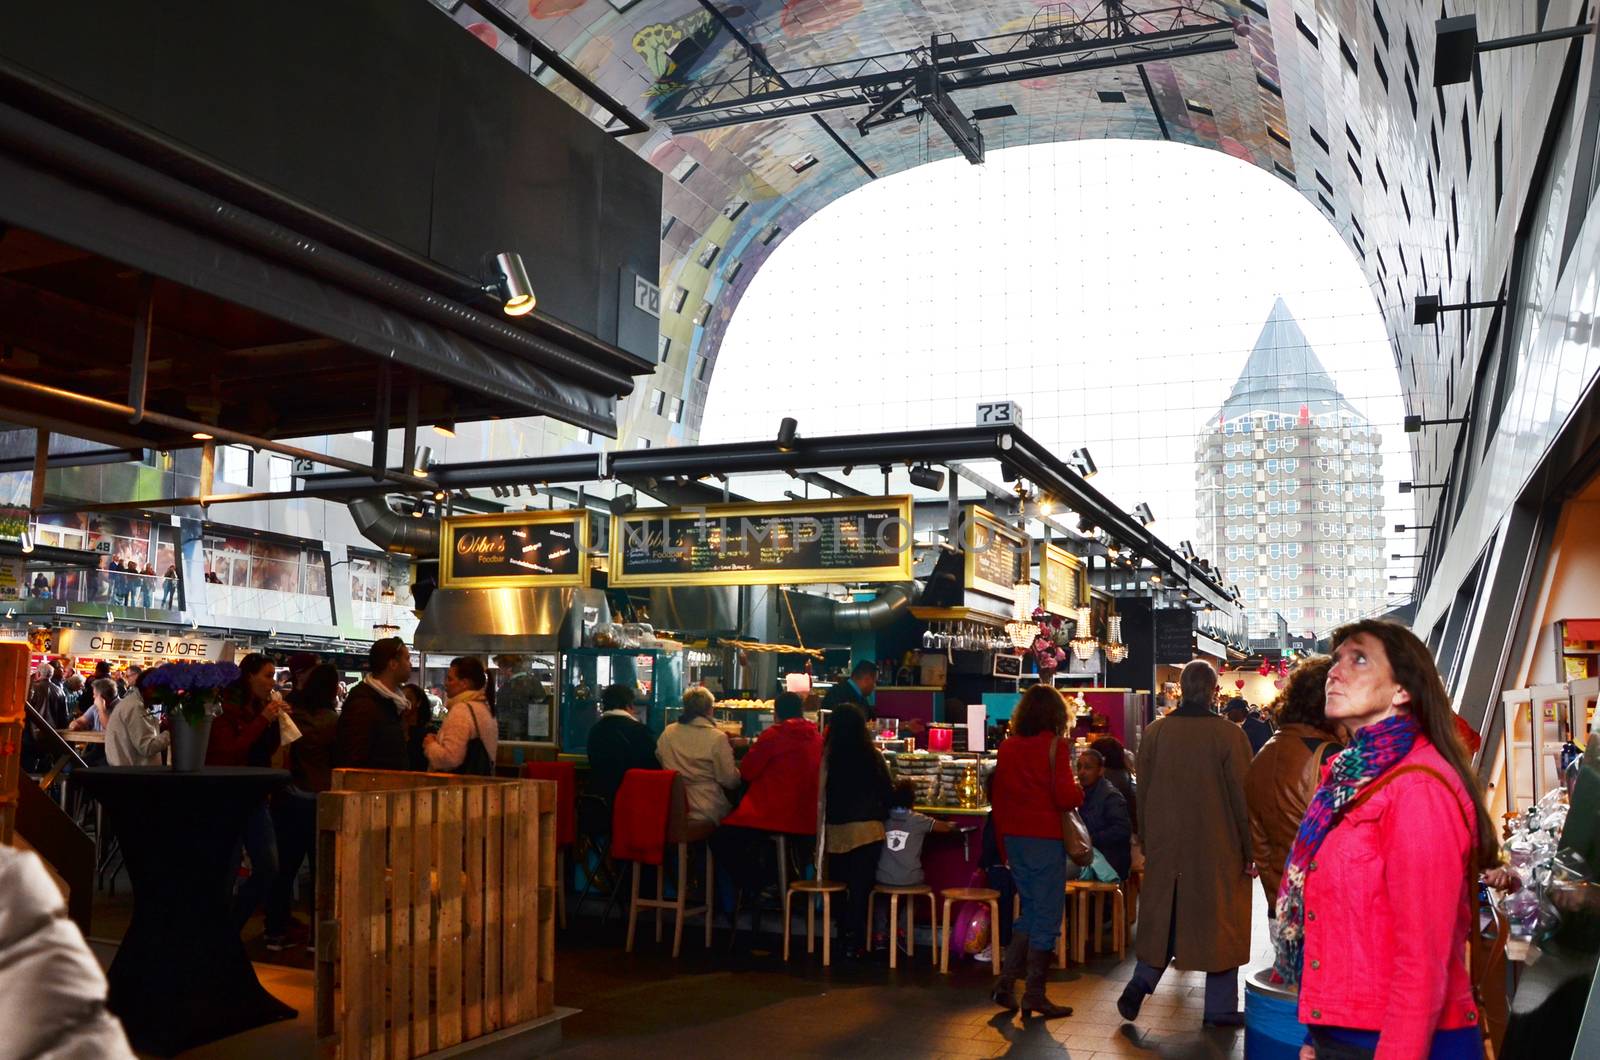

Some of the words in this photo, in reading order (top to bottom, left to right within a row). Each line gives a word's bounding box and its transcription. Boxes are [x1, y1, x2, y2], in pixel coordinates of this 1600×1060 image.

[637, 280, 660, 313] 70
[978, 404, 1010, 422] 73
[456, 533, 506, 555] Obba's
[478, 555, 506, 564] Foodbar
[155, 641, 165, 654] &
[166, 642, 209, 656] MORE
